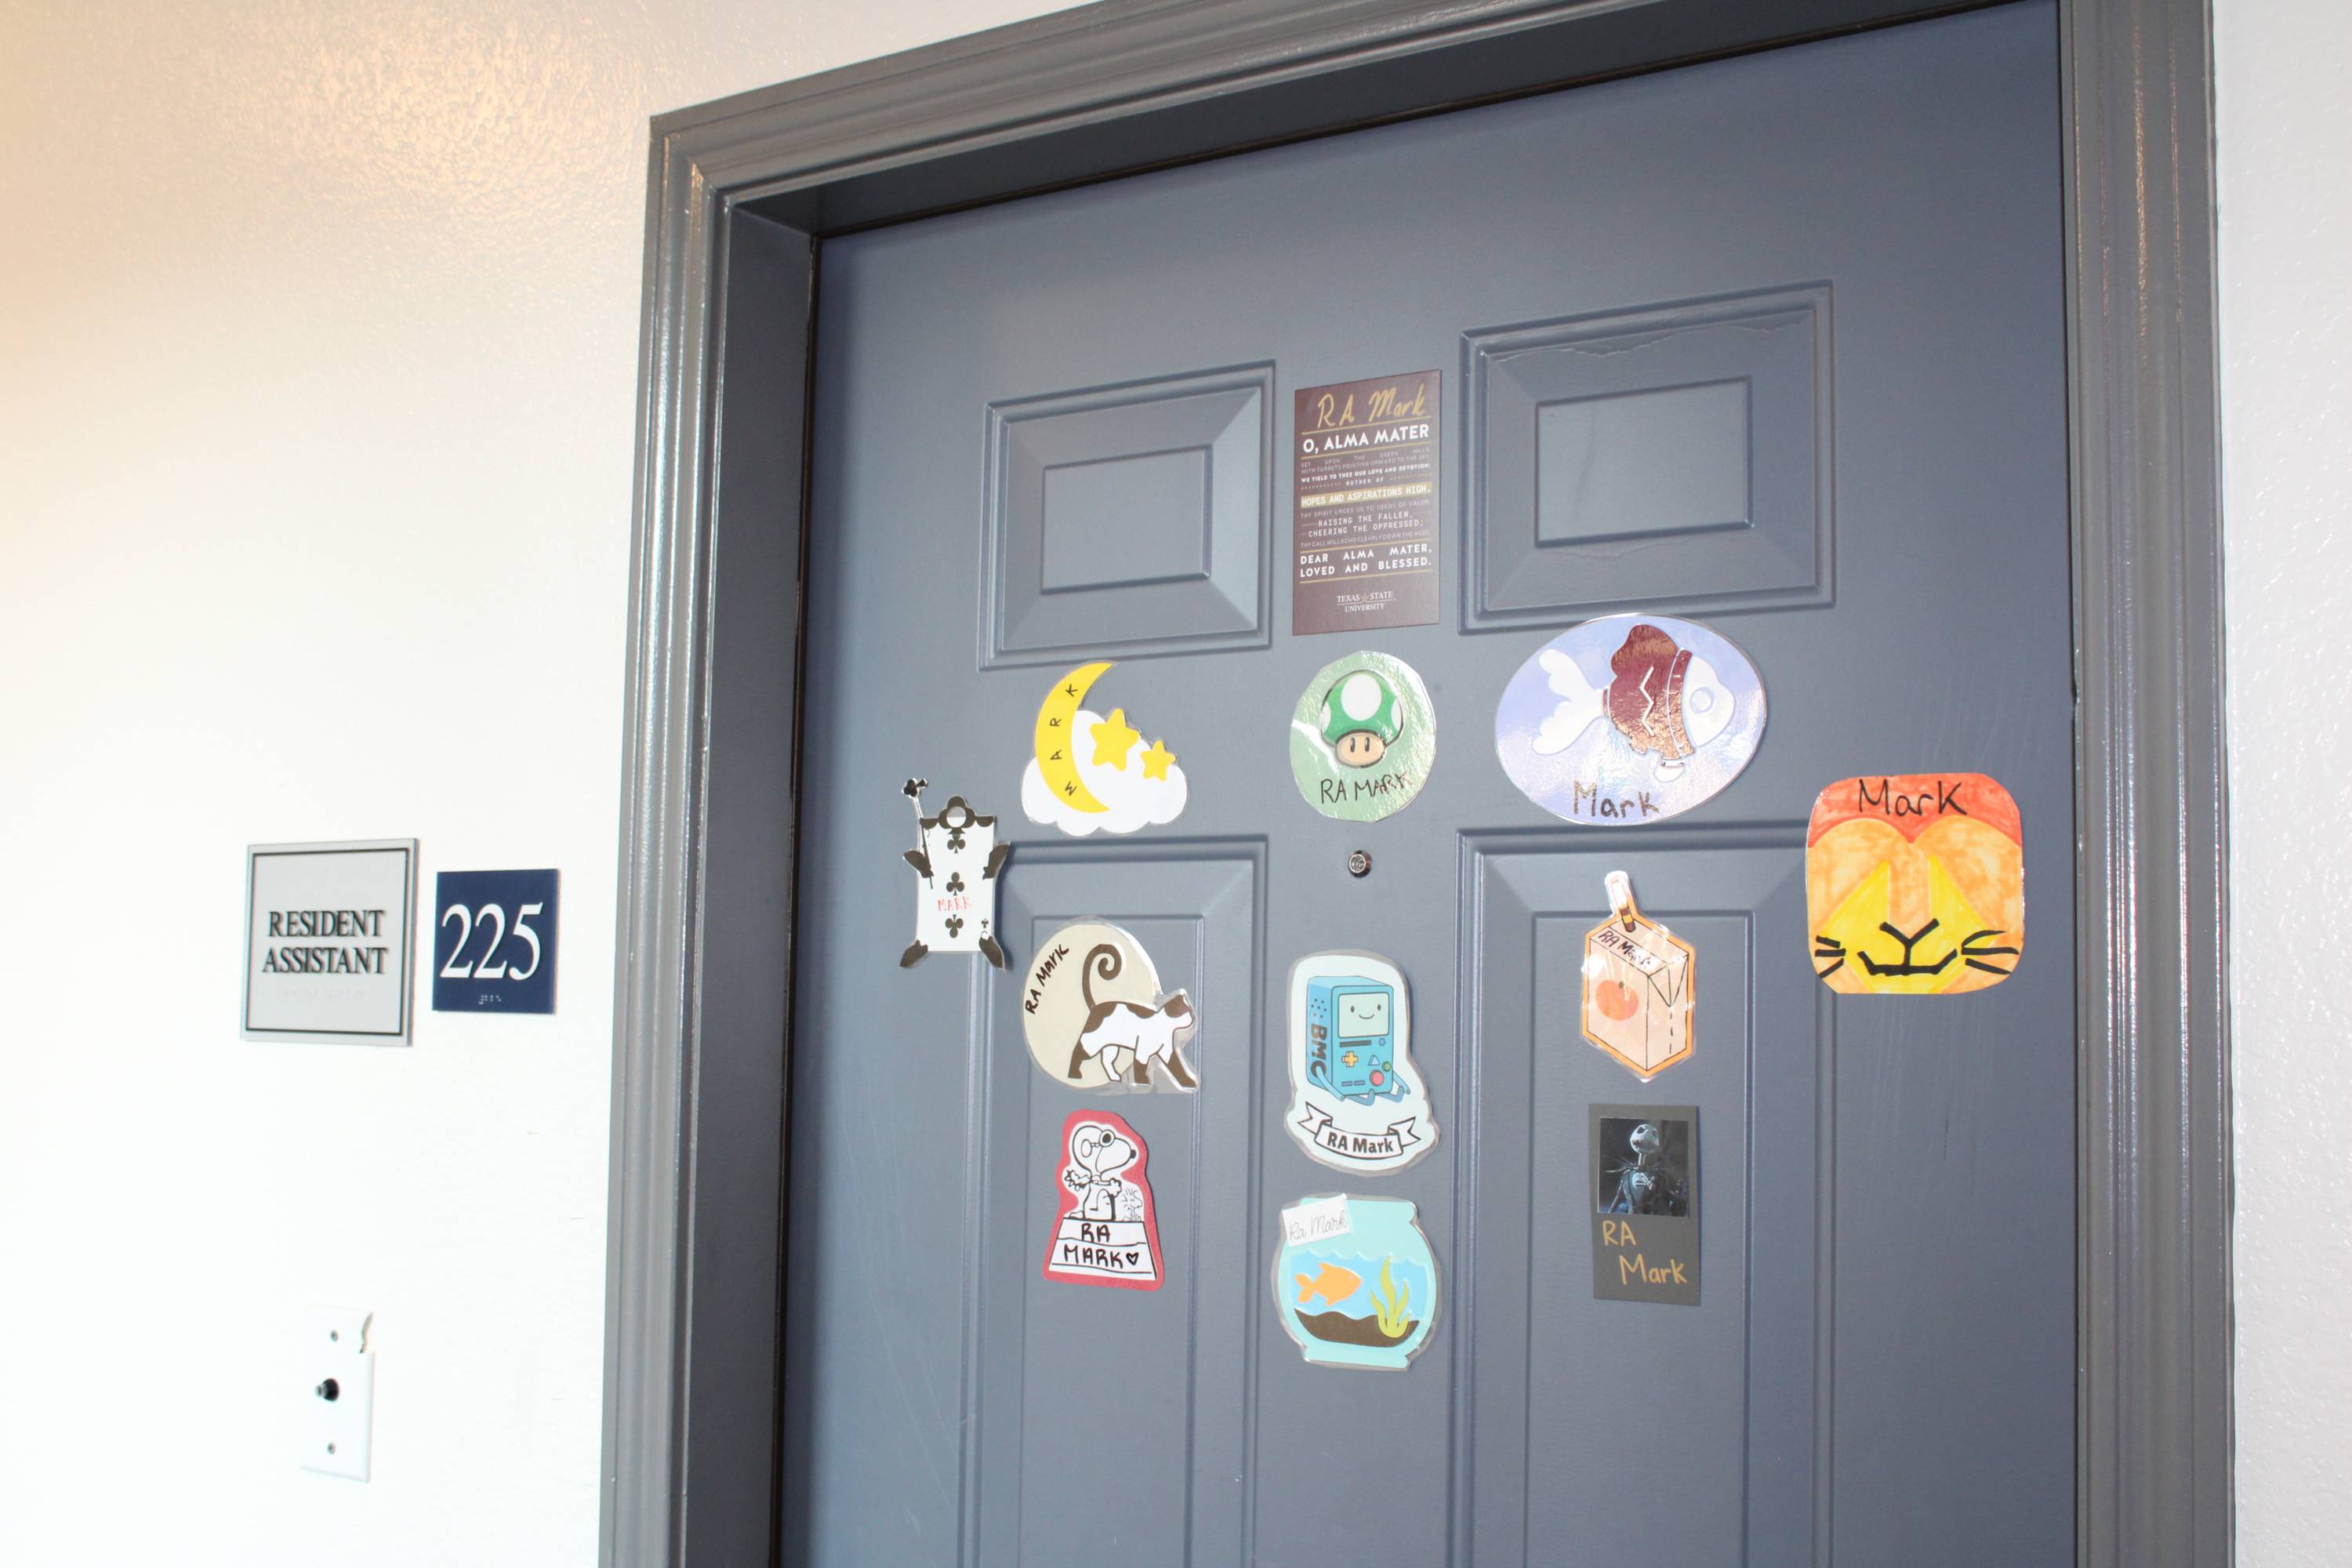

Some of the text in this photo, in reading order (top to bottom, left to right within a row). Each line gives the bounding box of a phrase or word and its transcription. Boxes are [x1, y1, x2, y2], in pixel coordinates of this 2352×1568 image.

[1368, 383, 1427, 423] Mark
[1303, 423, 1429, 455] O, ALMA MATER
[1301, 484, 1431, 507] HOPES AND ASPIRATIONS HIGH.
[1308, 527, 1348, 538] CHEERING
[1353, 524, 1368, 533] THE
[1318, 510, 1412, 527] RAISING THE FALLEN,
[1300, 543, 1432, 565] DEAR ALMA MATER,
[1300, 557, 1432, 578] LOVED AND BLESSED.
[1337, 590, 1394, 603] TEXAS STATE
[1345, 603, 1385, 612] UNIVERSITY
[1319, 771, 1413, 804] RA MARK
[267, 909, 385, 938] RESIDENT
[439, 902, 544, 981] 225
[1598, 930, 1621, 948] RA
[262, 946, 389, 975] ASSISTANT
[1025, 988, 1042, 1014] RA
[1327, 1131, 1395, 1155] RA Mark
[1081, 1222, 1111, 1244] RA
[1310, 1210, 1348, 1236] Mark
[1602, 1219, 1637, 1247] RA
[1063, 1243, 1124, 1269] MARK
